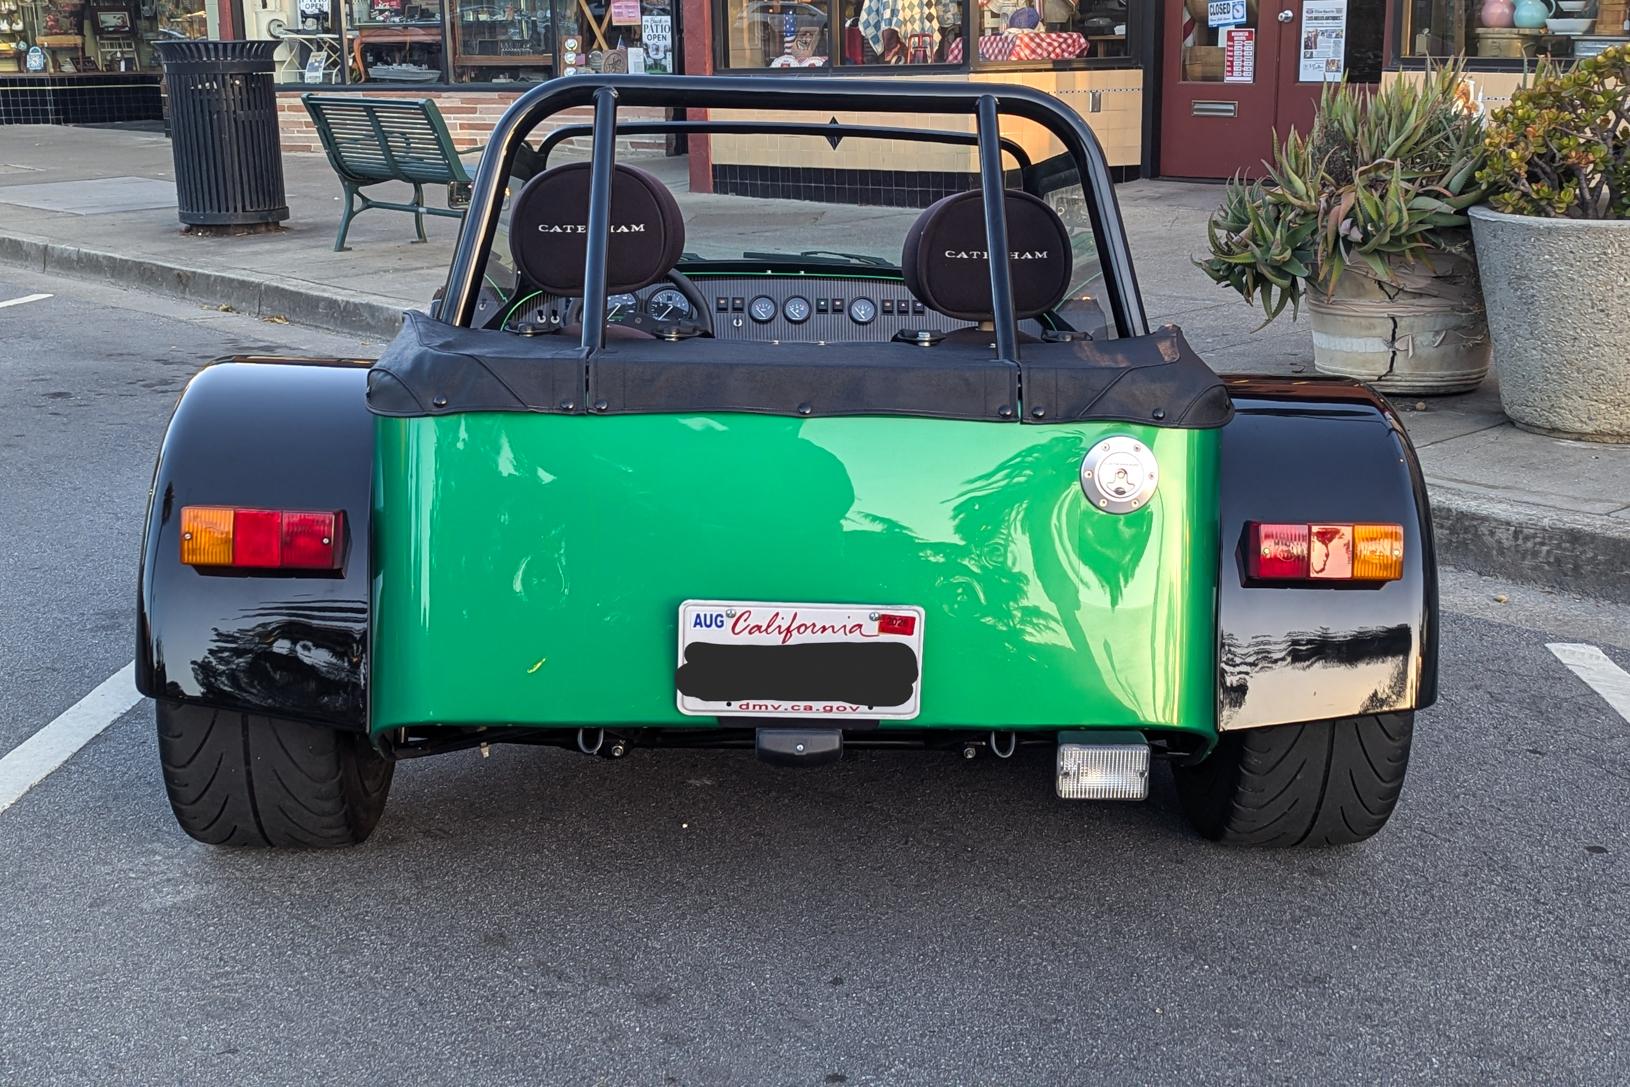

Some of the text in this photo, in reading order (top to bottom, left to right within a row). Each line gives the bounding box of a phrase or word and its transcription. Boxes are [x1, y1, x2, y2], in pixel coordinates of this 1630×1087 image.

[1209, 3, 1231, 16] CLOSED
[643, 23, 671, 33] PATIO
[693, 610, 880, 644] AUG California
[738, 702, 860, 712] dmv.ca.gov
